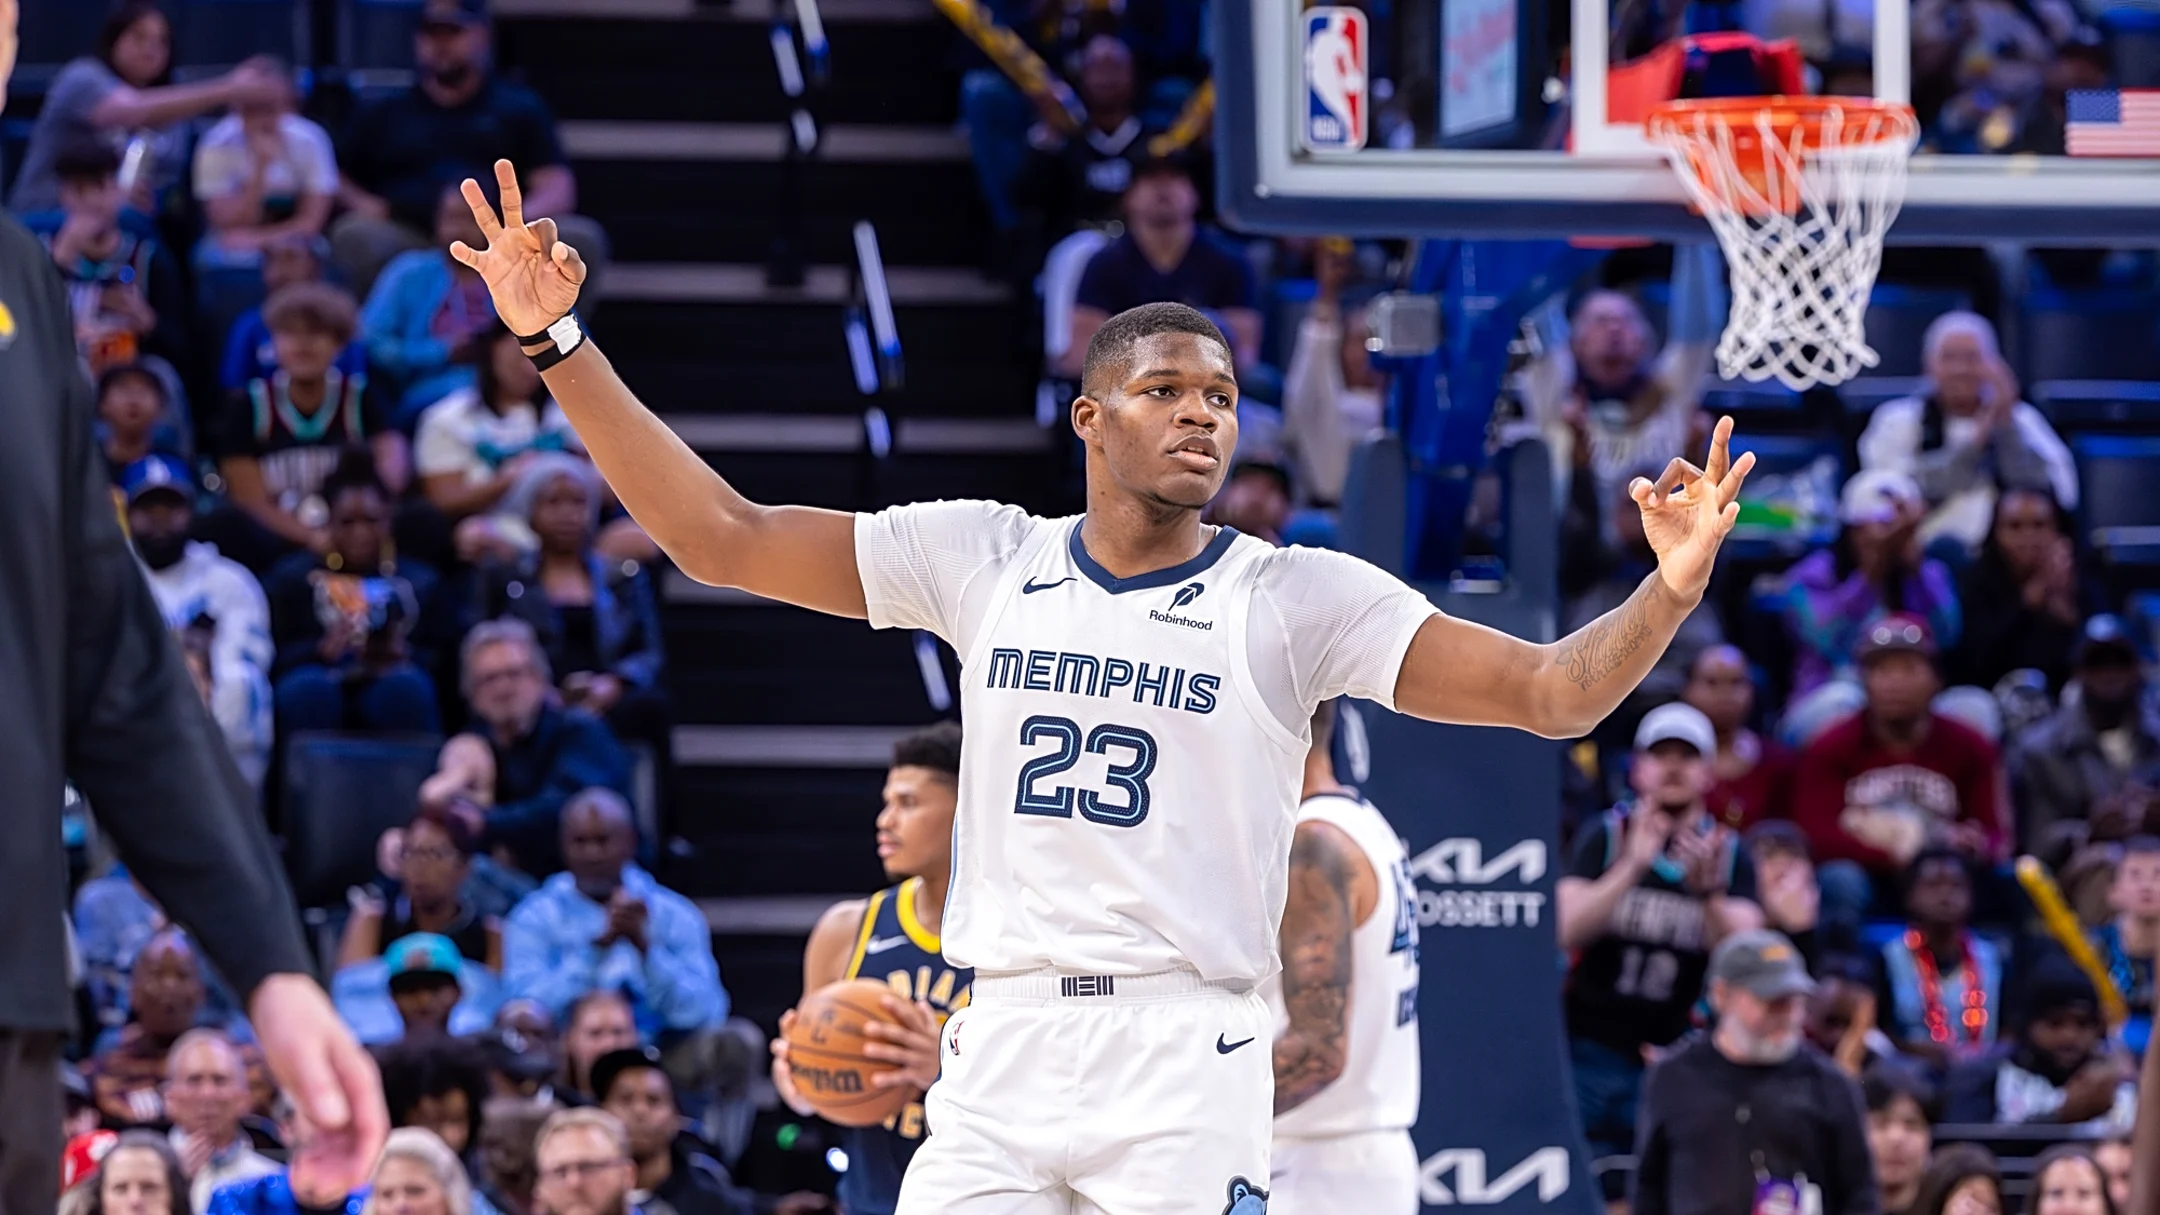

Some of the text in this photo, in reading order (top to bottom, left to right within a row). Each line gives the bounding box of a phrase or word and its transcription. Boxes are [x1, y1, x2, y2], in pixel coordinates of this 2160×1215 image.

[1149, 609, 1213, 631] Robinhood
[987, 648, 1221, 714] MEMPHIS
[1014, 715, 1157, 828] 23
[1417, 890, 1547, 927] OSSETT
